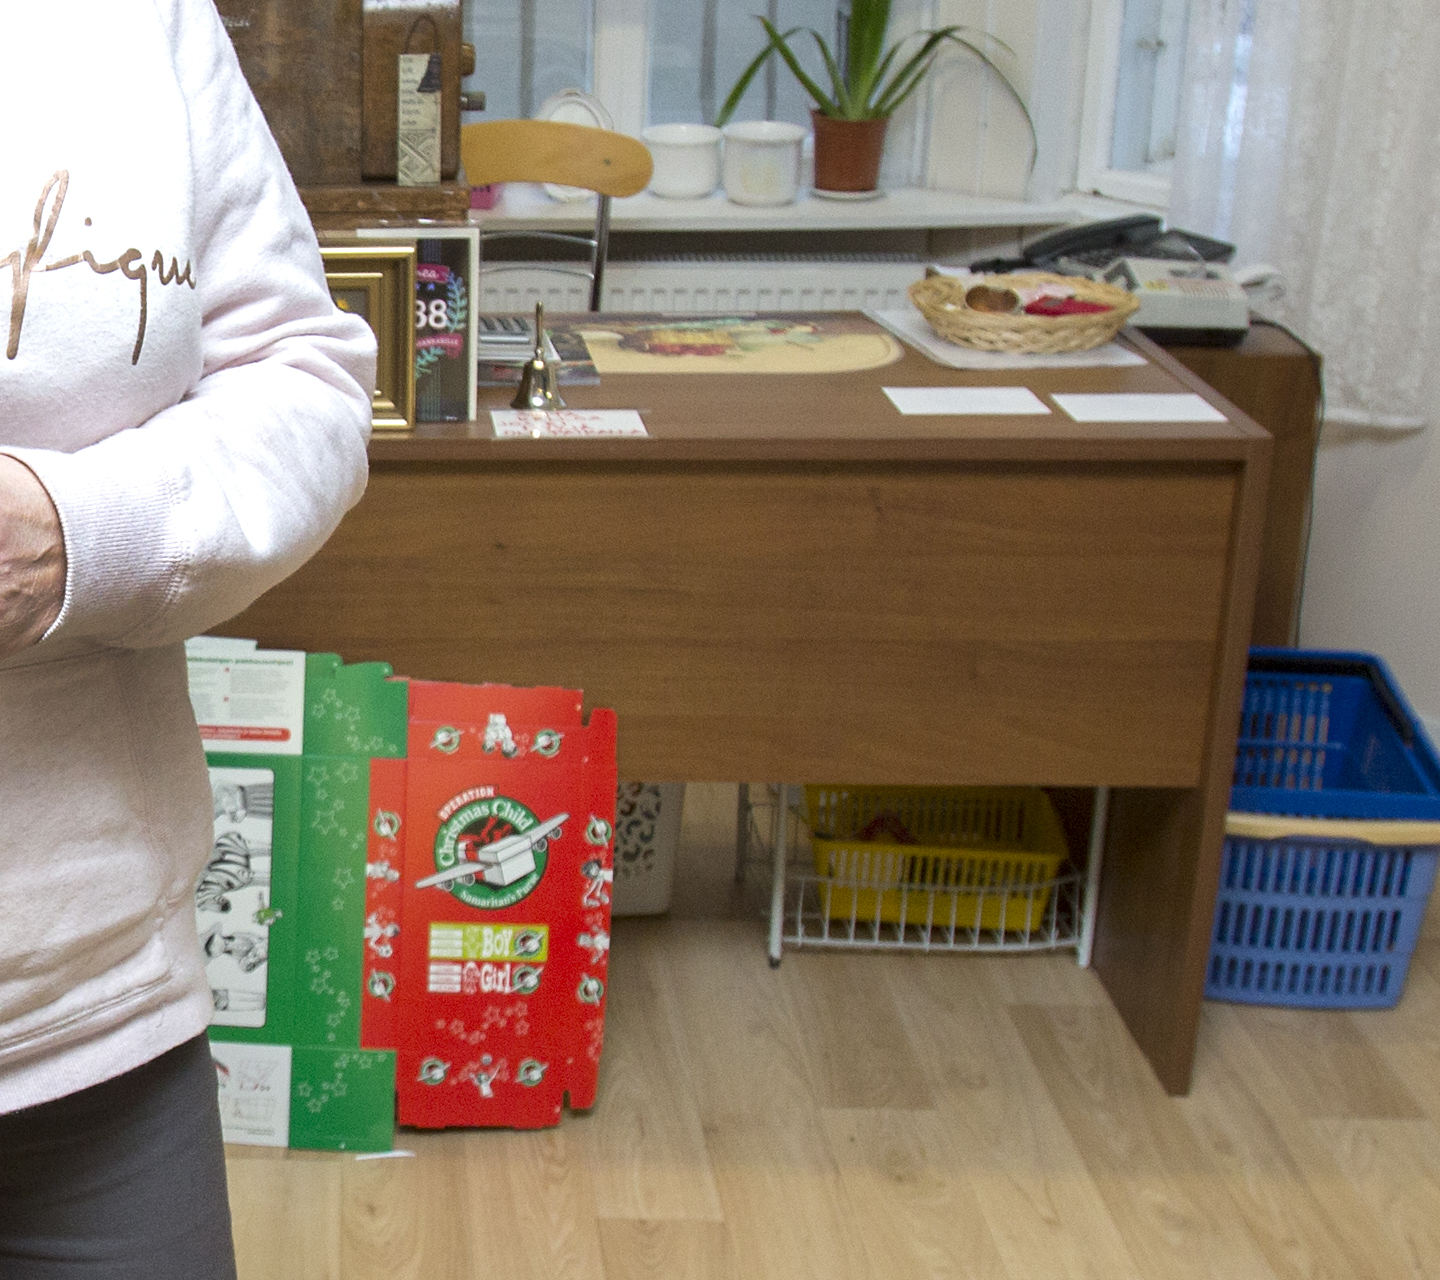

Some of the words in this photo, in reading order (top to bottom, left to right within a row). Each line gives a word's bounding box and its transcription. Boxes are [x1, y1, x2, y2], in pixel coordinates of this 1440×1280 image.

[439, 786, 495, 820] OPERATION
[438, 803, 491, 867] Christmas
[492, 799, 535, 832] Child
